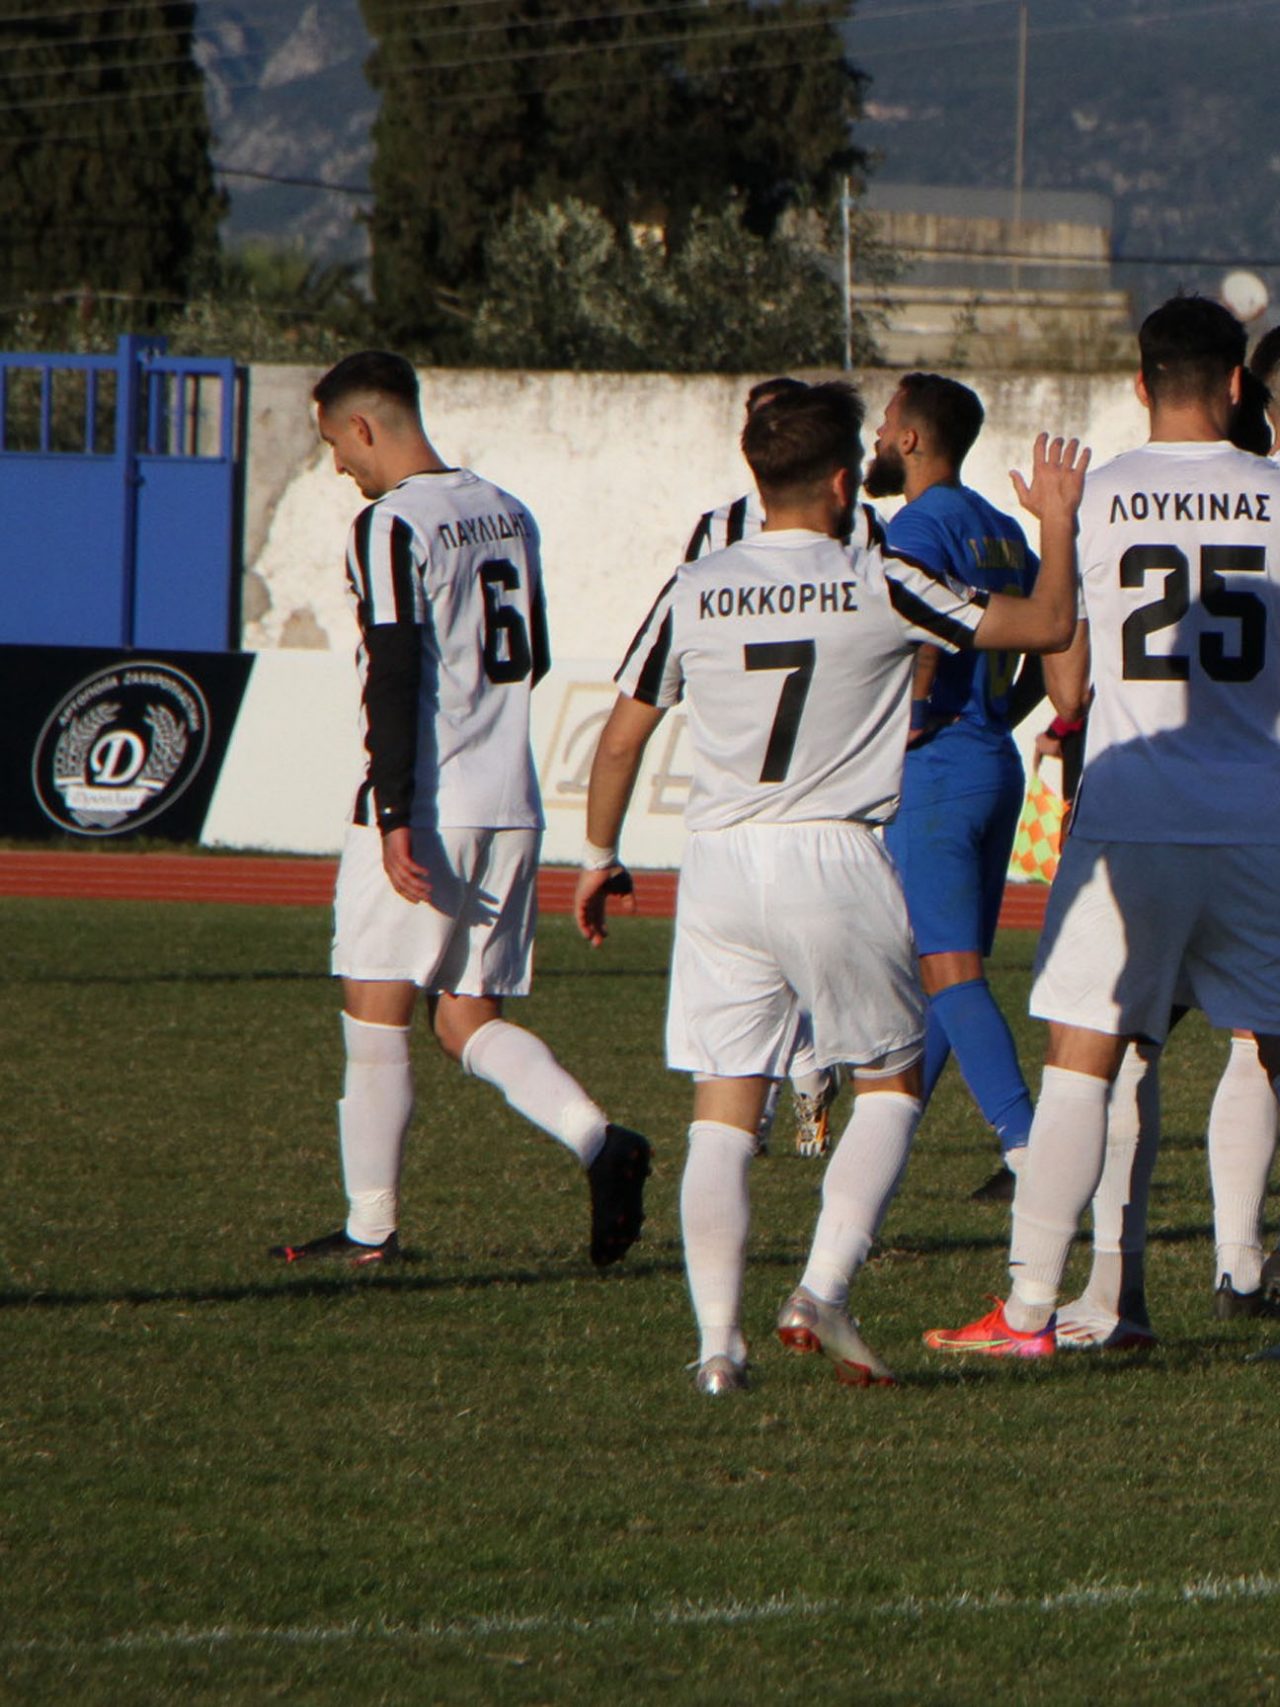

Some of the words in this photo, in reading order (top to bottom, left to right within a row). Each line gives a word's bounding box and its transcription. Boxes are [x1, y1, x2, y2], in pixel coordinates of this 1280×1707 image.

[1109, 492, 1271, 523] ΛΟΥΚΙΝΑΣ
[479, 559, 532, 684] 6
[699, 581, 858, 618] ΚΟΚΚΟΡΗΣ
[1119, 544, 1267, 683] 25
[744, 639, 815, 783] 7
